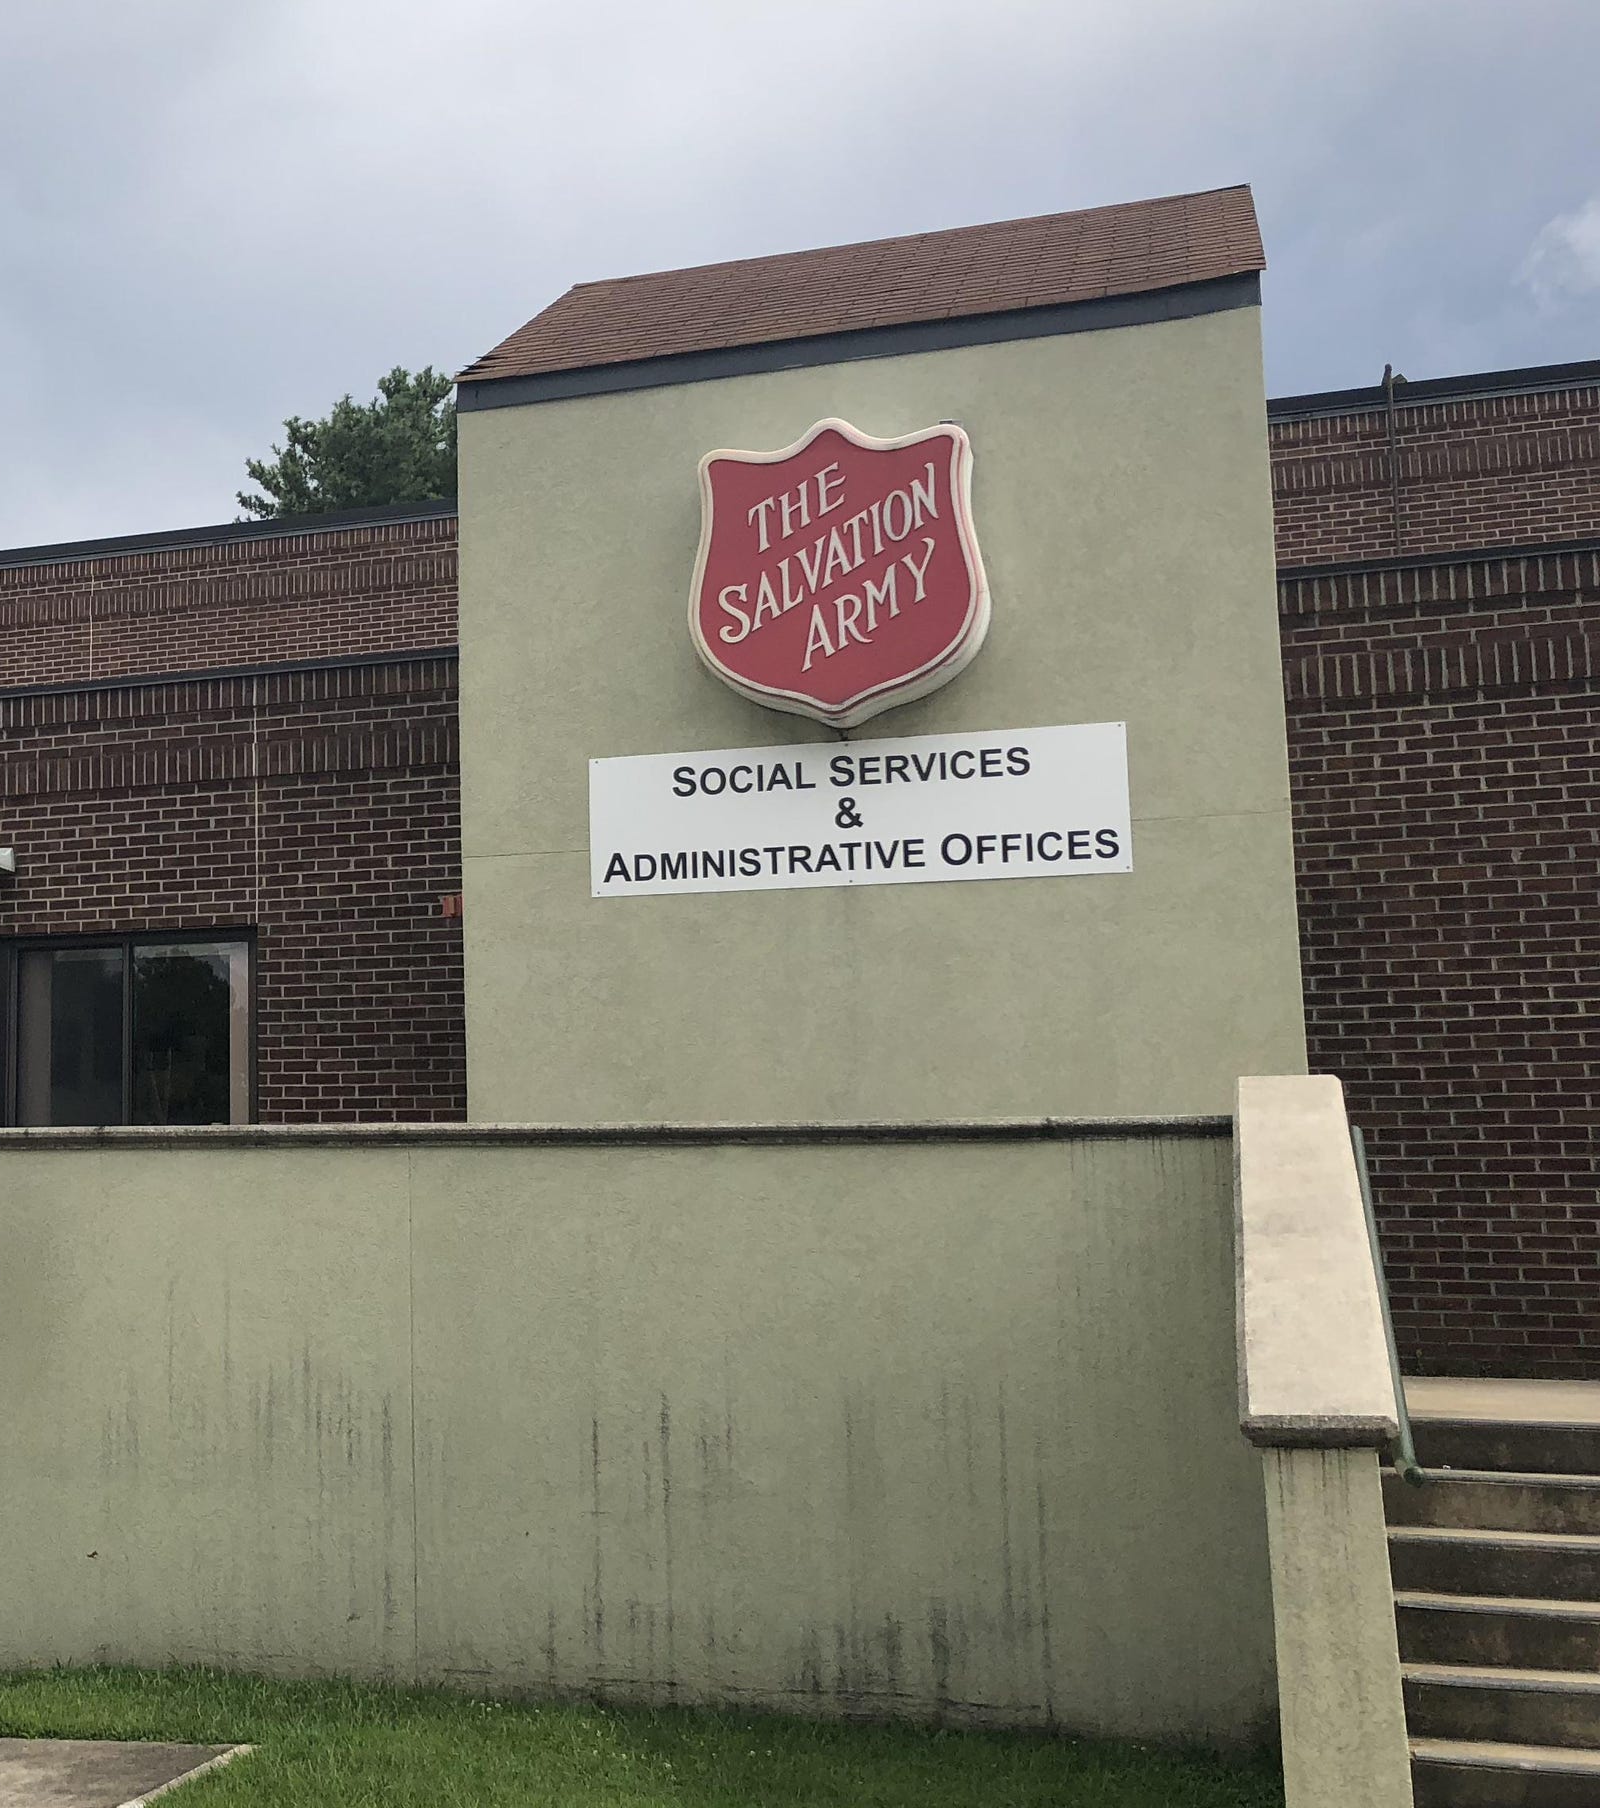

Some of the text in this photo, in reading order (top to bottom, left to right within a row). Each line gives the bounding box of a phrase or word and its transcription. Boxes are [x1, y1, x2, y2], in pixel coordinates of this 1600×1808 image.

[748, 461, 846, 553] THE
[718, 462, 939, 643] SALVATION
[801, 537, 935, 673] ARMY
[672, 746, 1031, 798] SOCIAL SERVICES
[835, 796, 864, 829] &
[603, 828, 1120, 883] ADMINISTRATIVE OFFICES
